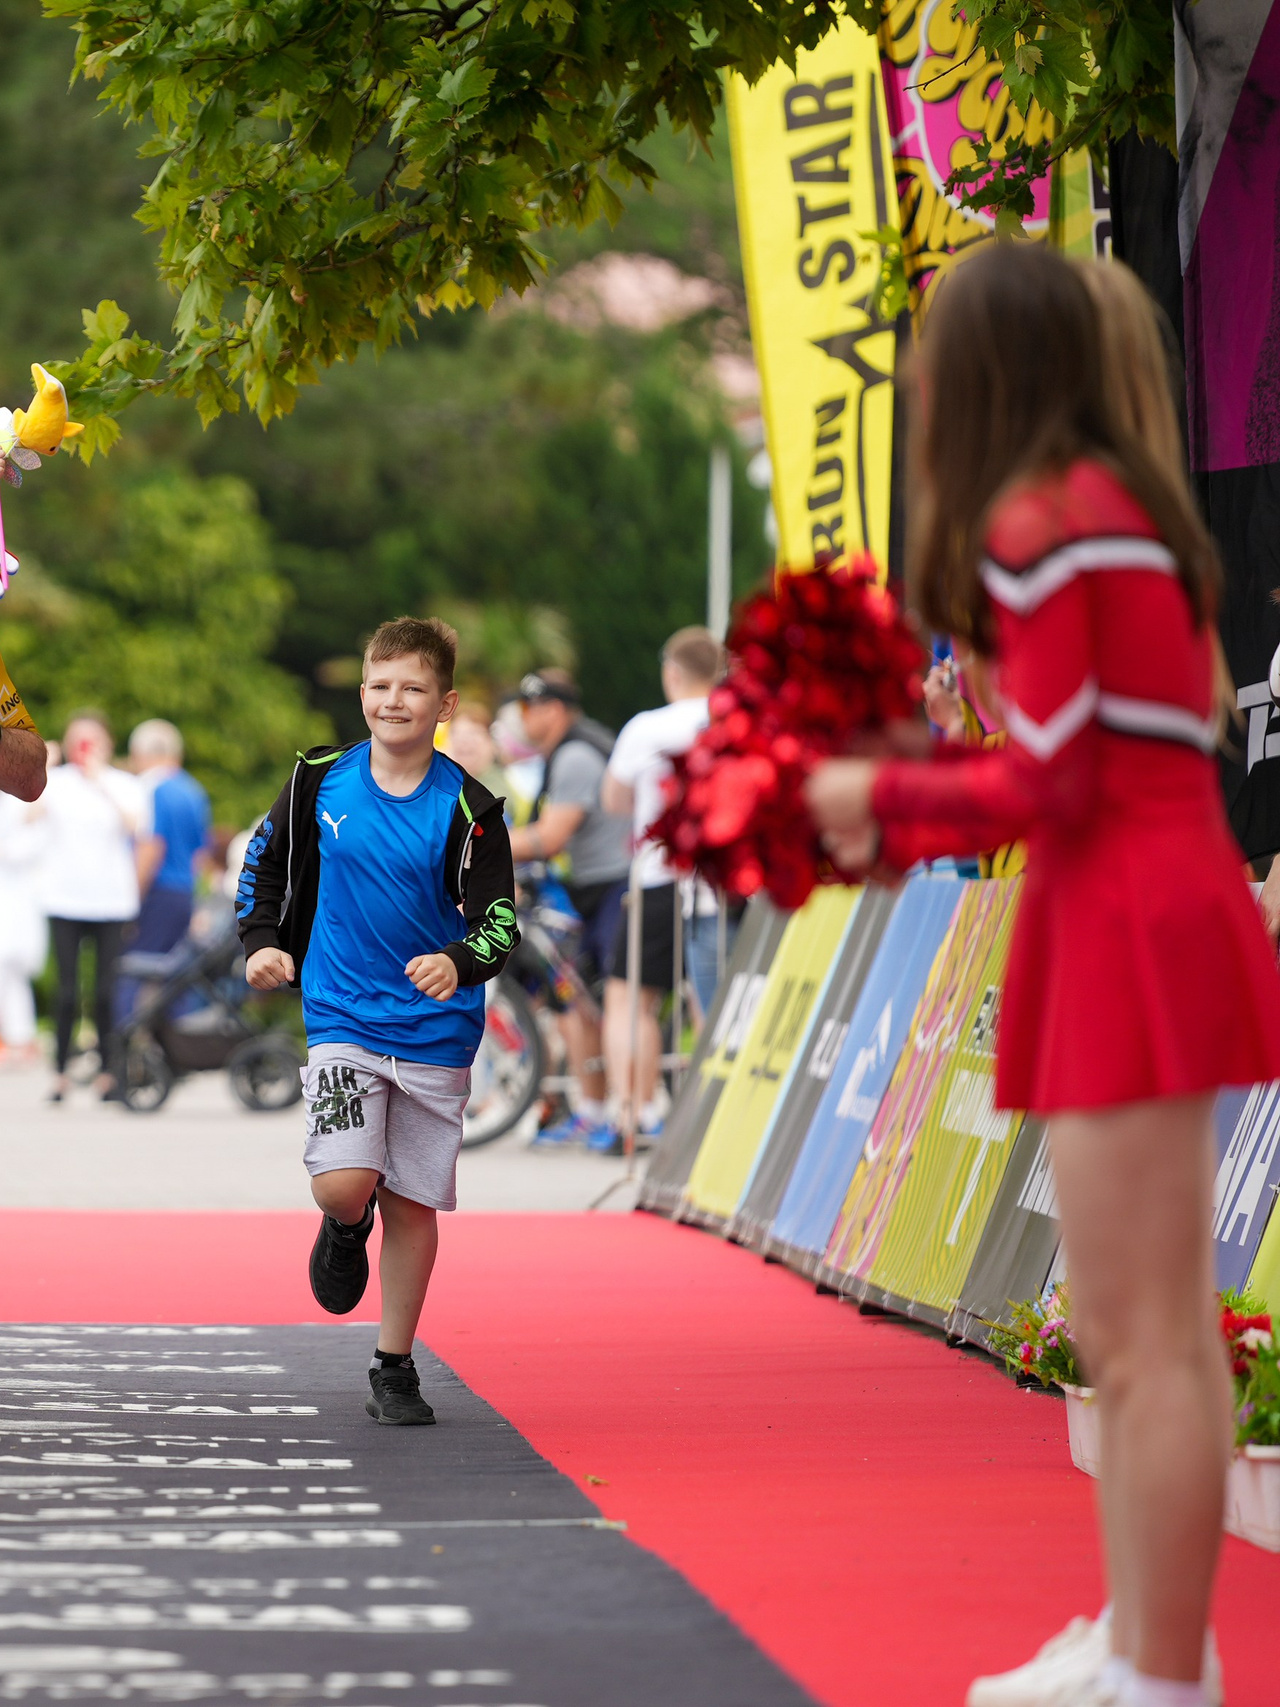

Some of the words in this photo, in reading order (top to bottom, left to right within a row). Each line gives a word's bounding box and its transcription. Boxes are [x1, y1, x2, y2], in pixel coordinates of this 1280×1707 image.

[784, 74, 856, 289] STAR
[317, 1066, 358, 1098] AIR
[29, 1401, 319, 1415] STAR
[39, 1452, 353, 1469] STAR
